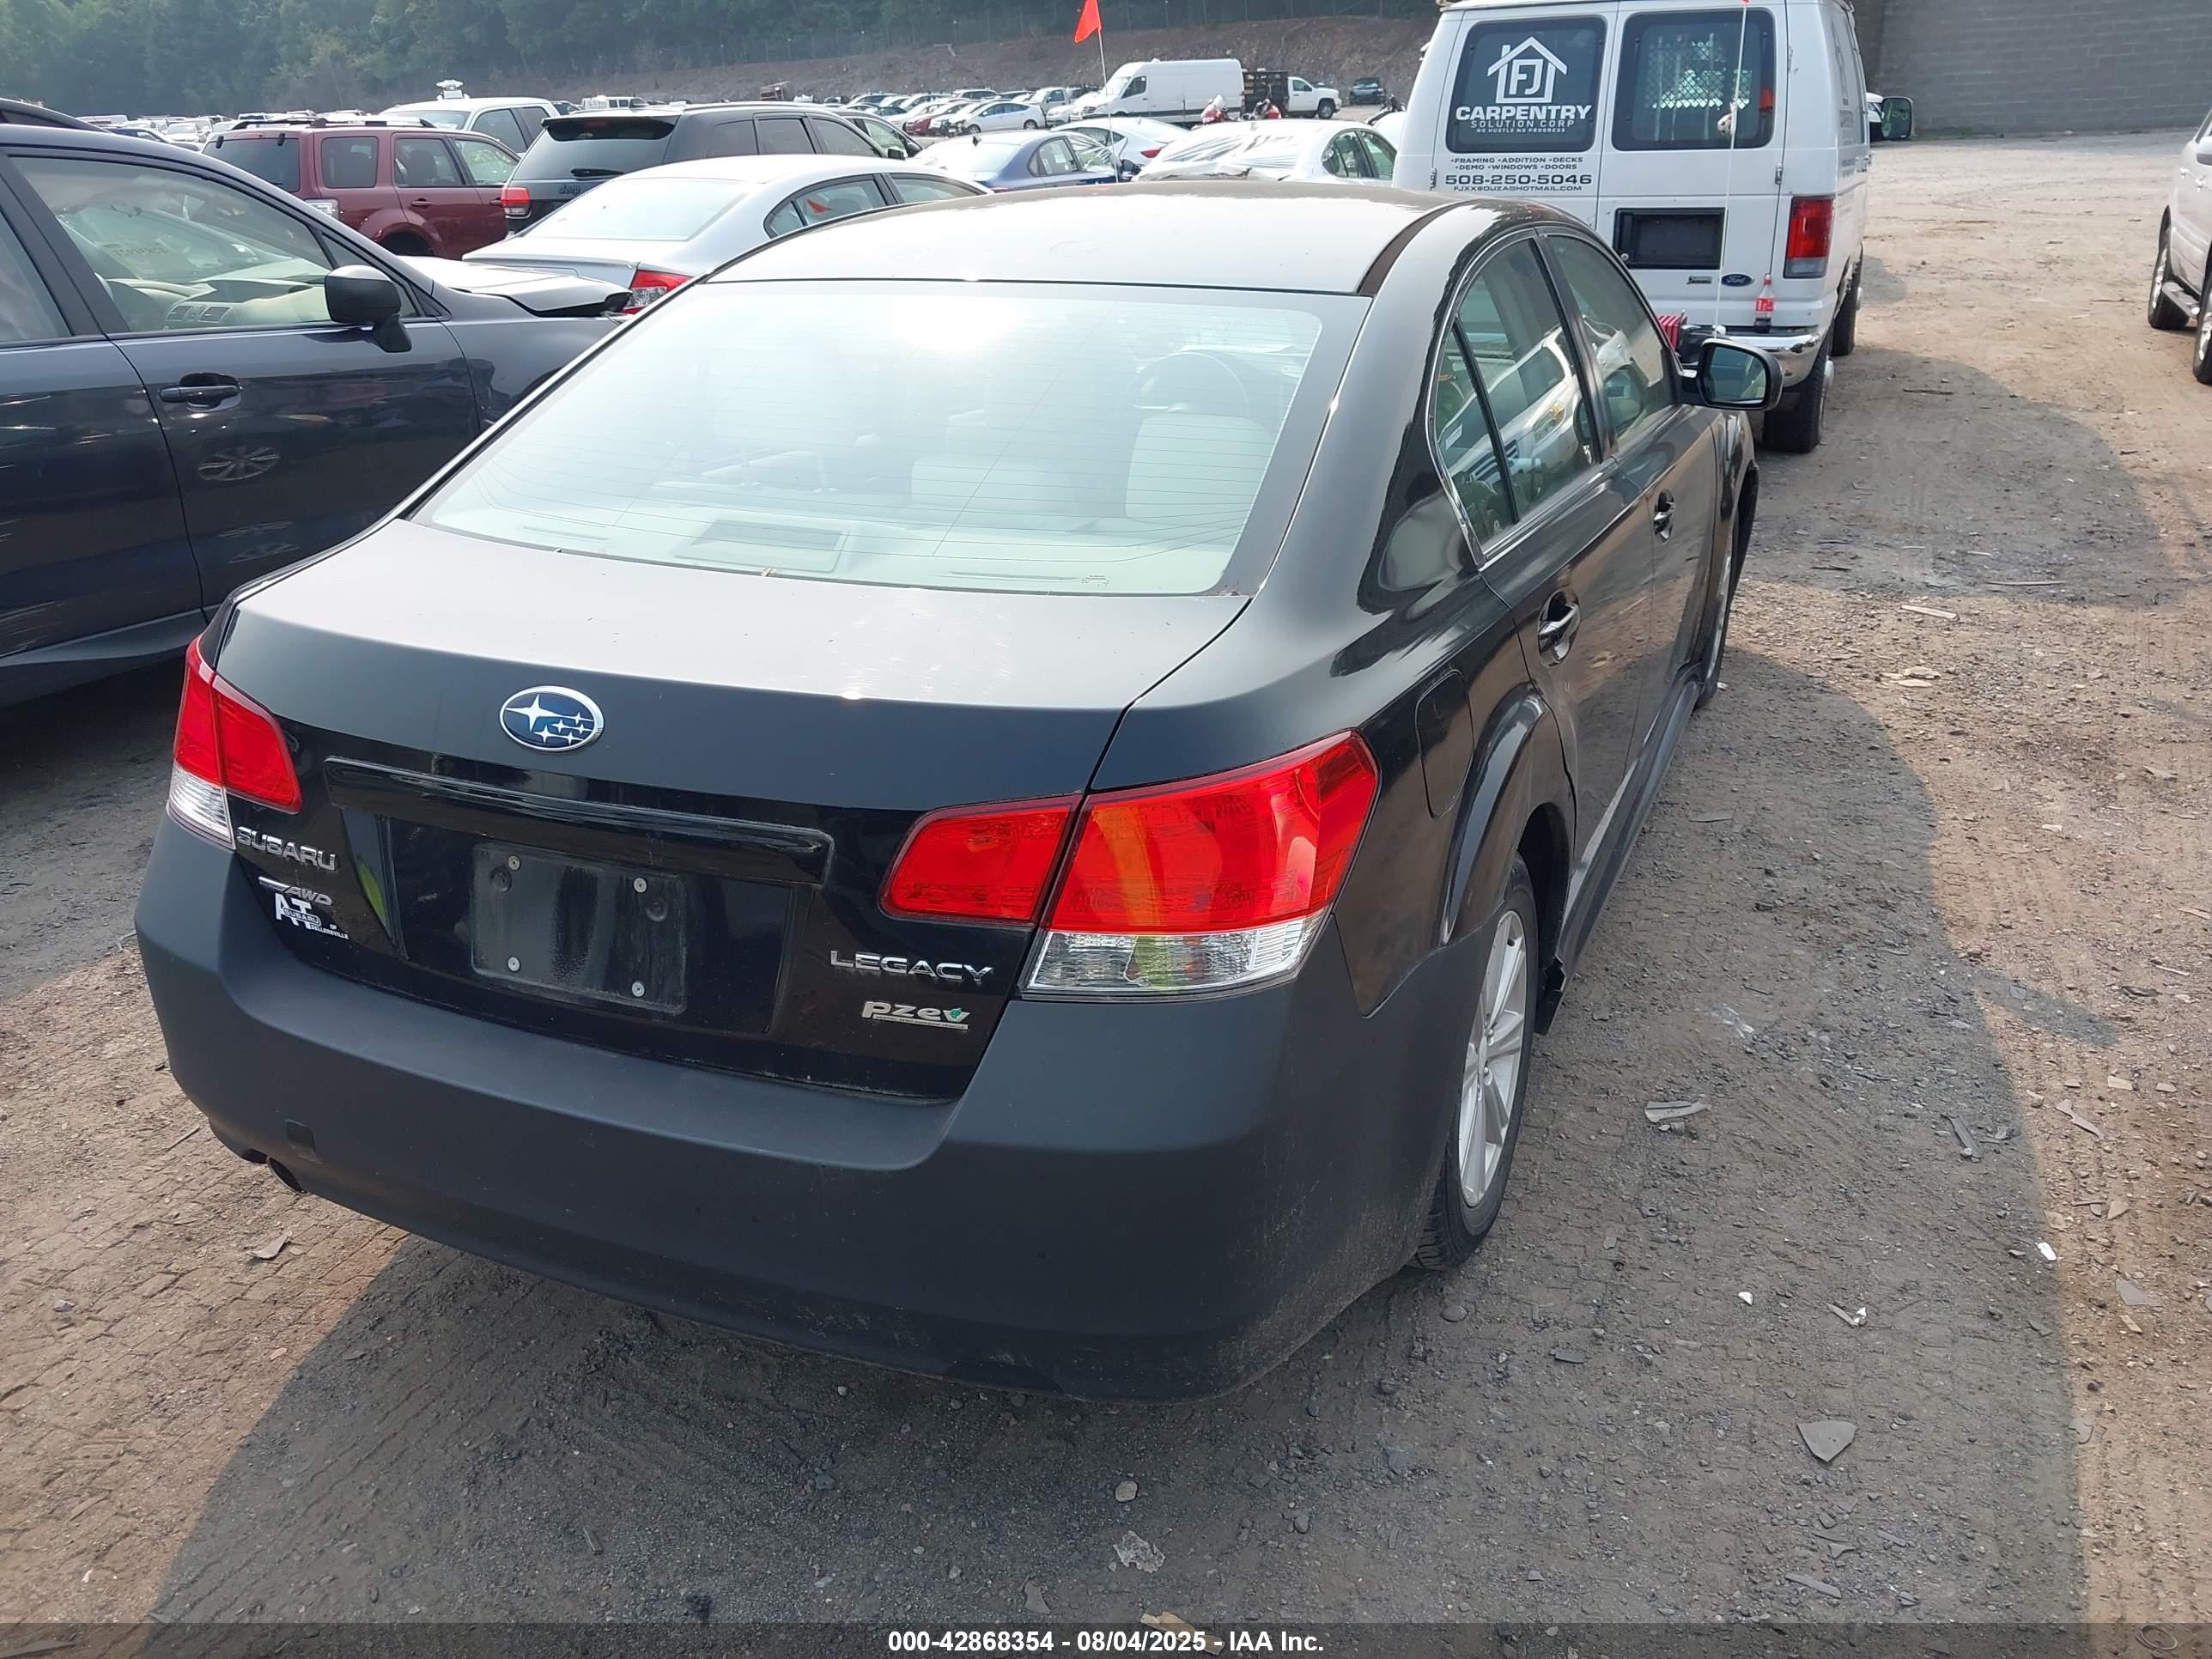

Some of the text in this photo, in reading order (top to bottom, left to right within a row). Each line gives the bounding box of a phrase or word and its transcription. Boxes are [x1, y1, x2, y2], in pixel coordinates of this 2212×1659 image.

[1509, 59, 1544, 95] FJ
[1455, 106, 1592, 120] CARPENTRY
[1540, 119, 1575, 128] CORP
[1445, 174, 1592, 185] 508-250-5046
[237, 826, 337, 871] SUBARU
[285, 886, 333, 906] AWD
[283, 908, 321, 925] SUBARU
[830, 951, 994, 981] LEGACY
